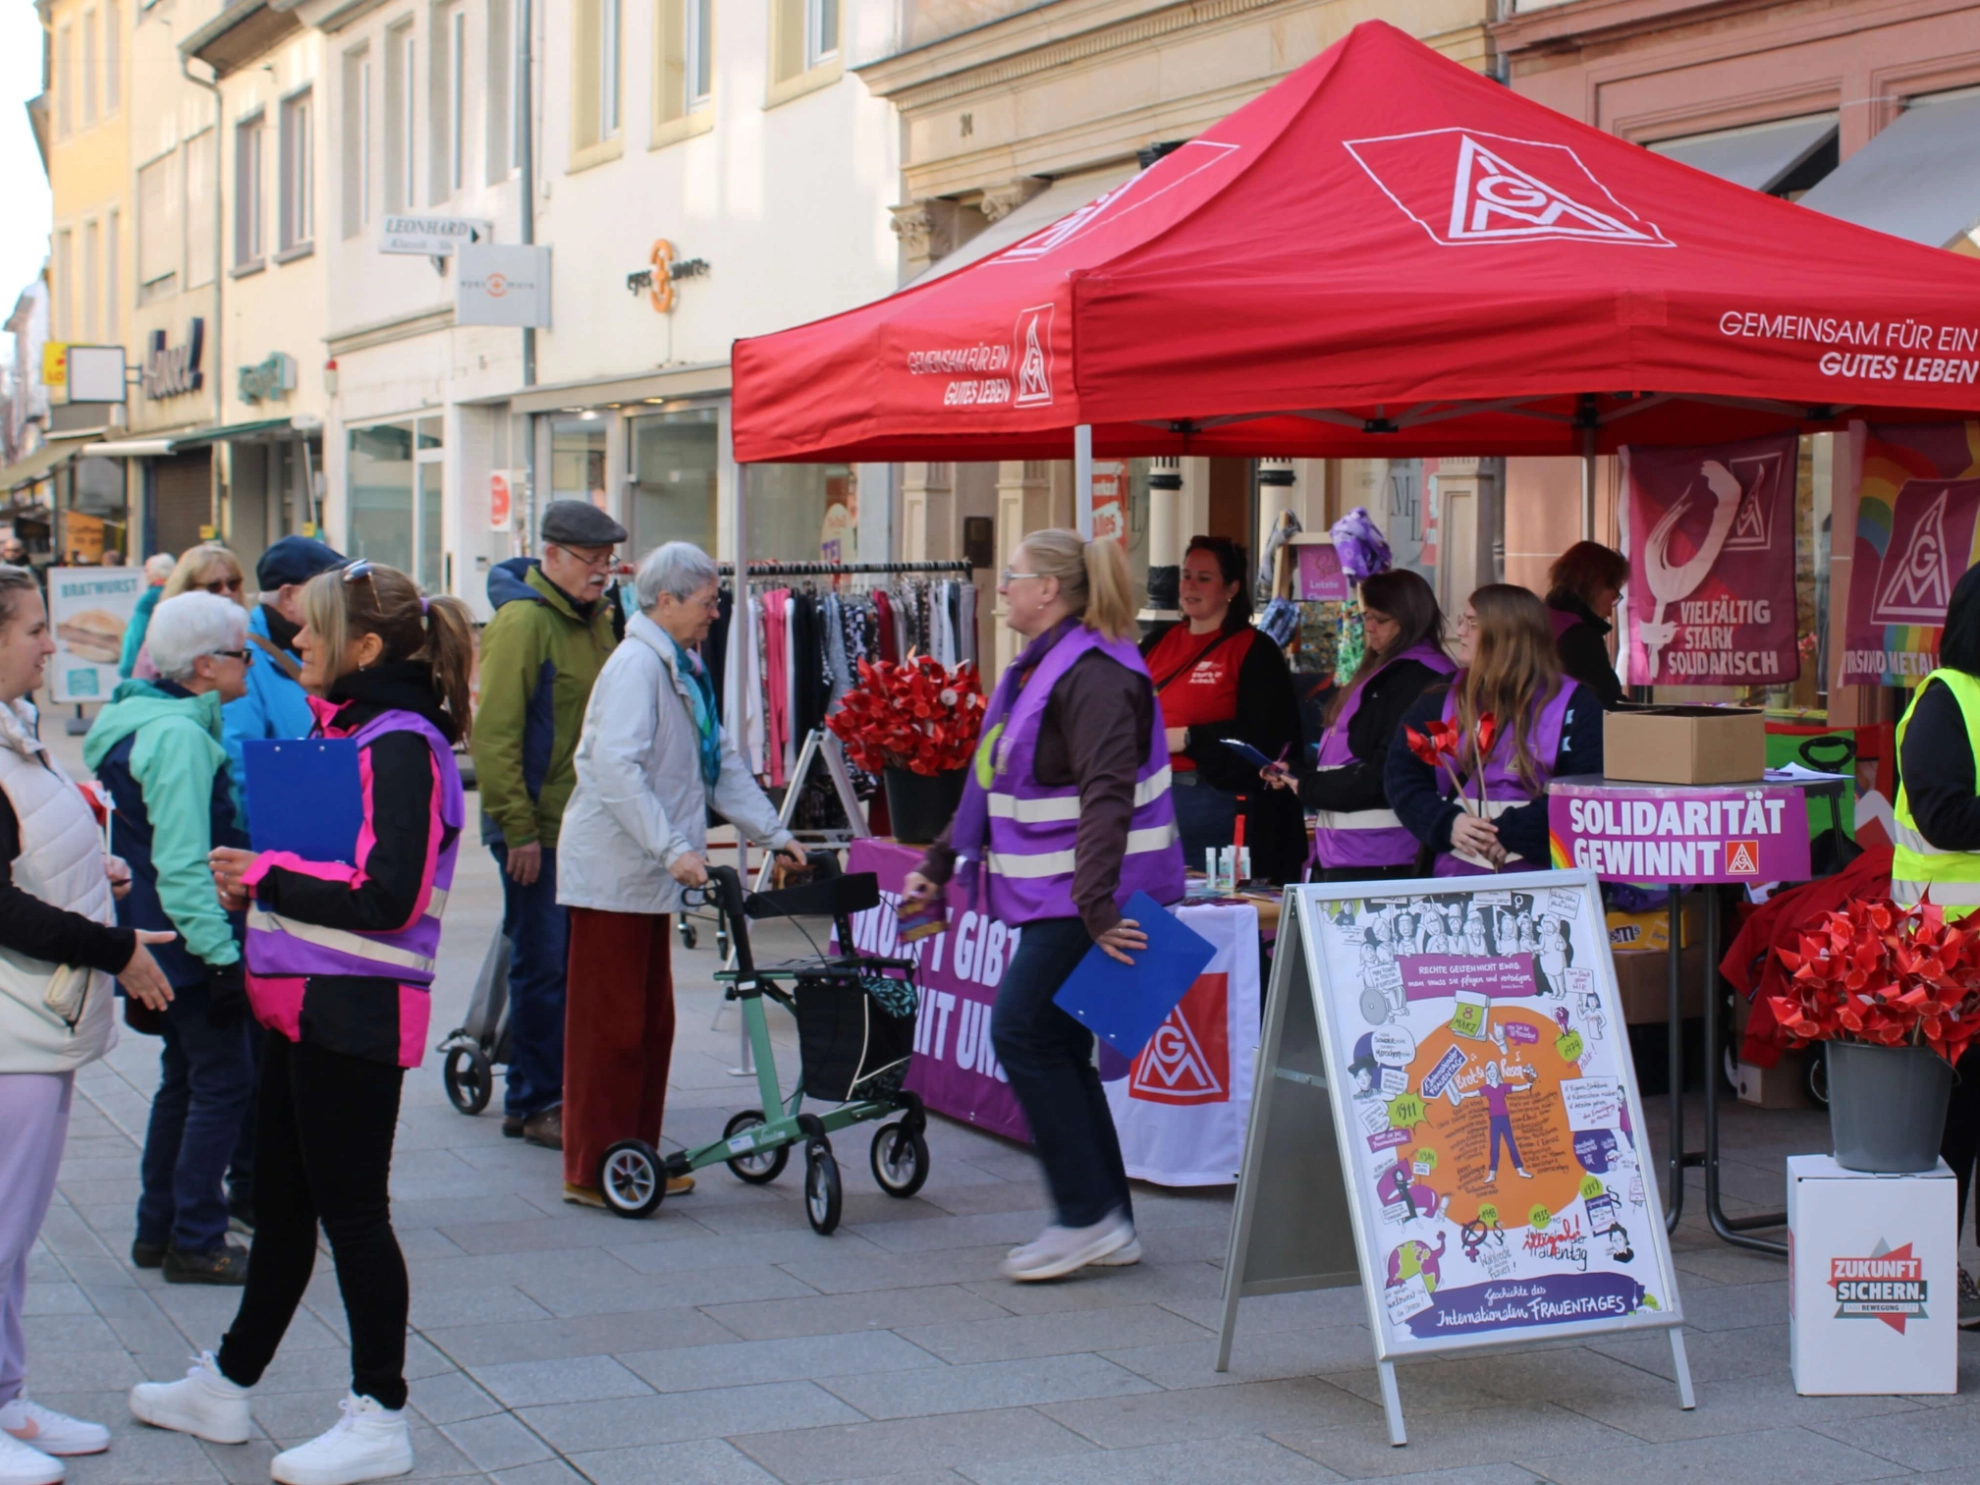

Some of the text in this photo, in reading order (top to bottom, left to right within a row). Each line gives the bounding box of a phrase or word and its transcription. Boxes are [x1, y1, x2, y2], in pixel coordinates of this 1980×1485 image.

[386, 218, 469, 236] LEONHARD
[1719, 310, 1979, 352] GEMEINSAM FÜR EIN
[907, 341, 1011, 375] GEMEINSAM FÜR EIN
[1819, 351, 1980, 384] GUTES LEBEN
[943, 378, 1011, 405] GUTES LEBEN
[61, 578, 138, 598] BRATWURST
[1680, 594, 1771, 625] VIELFÄLTIG
[1684, 625, 1733, 650] STARK
[1668, 650, 1779, 676] SOLIDARISCH
[1569, 790, 1785, 836] SOLIDARITÄT
[1574, 838, 1721, 876] GEWINNT
[1408, 979, 1424, 988] man
[1486, 973, 1498, 983] und
[1418, 964, 1448, 975] RECHTE
[1449, 963, 1476, 974] GELTEN
[1476, 962, 1497, 973] NICHT
[1463, 1006, 1473, 1020] 8
[1428, 1056, 1465, 1096] FRAUENTAG
[1455, 1069, 1477, 1089] Brot
[1396, 1102, 1417, 1120] 1911
[1834, 1259, 1918, 1278] ZUKUNFT
[1484, 1283, 1547, 1306] Geschichte des
[1837, 1281, 1926, 1300] SICHERN.
[1436, 1294, 1626, 1328] Internationalen FRAUENTAGES
